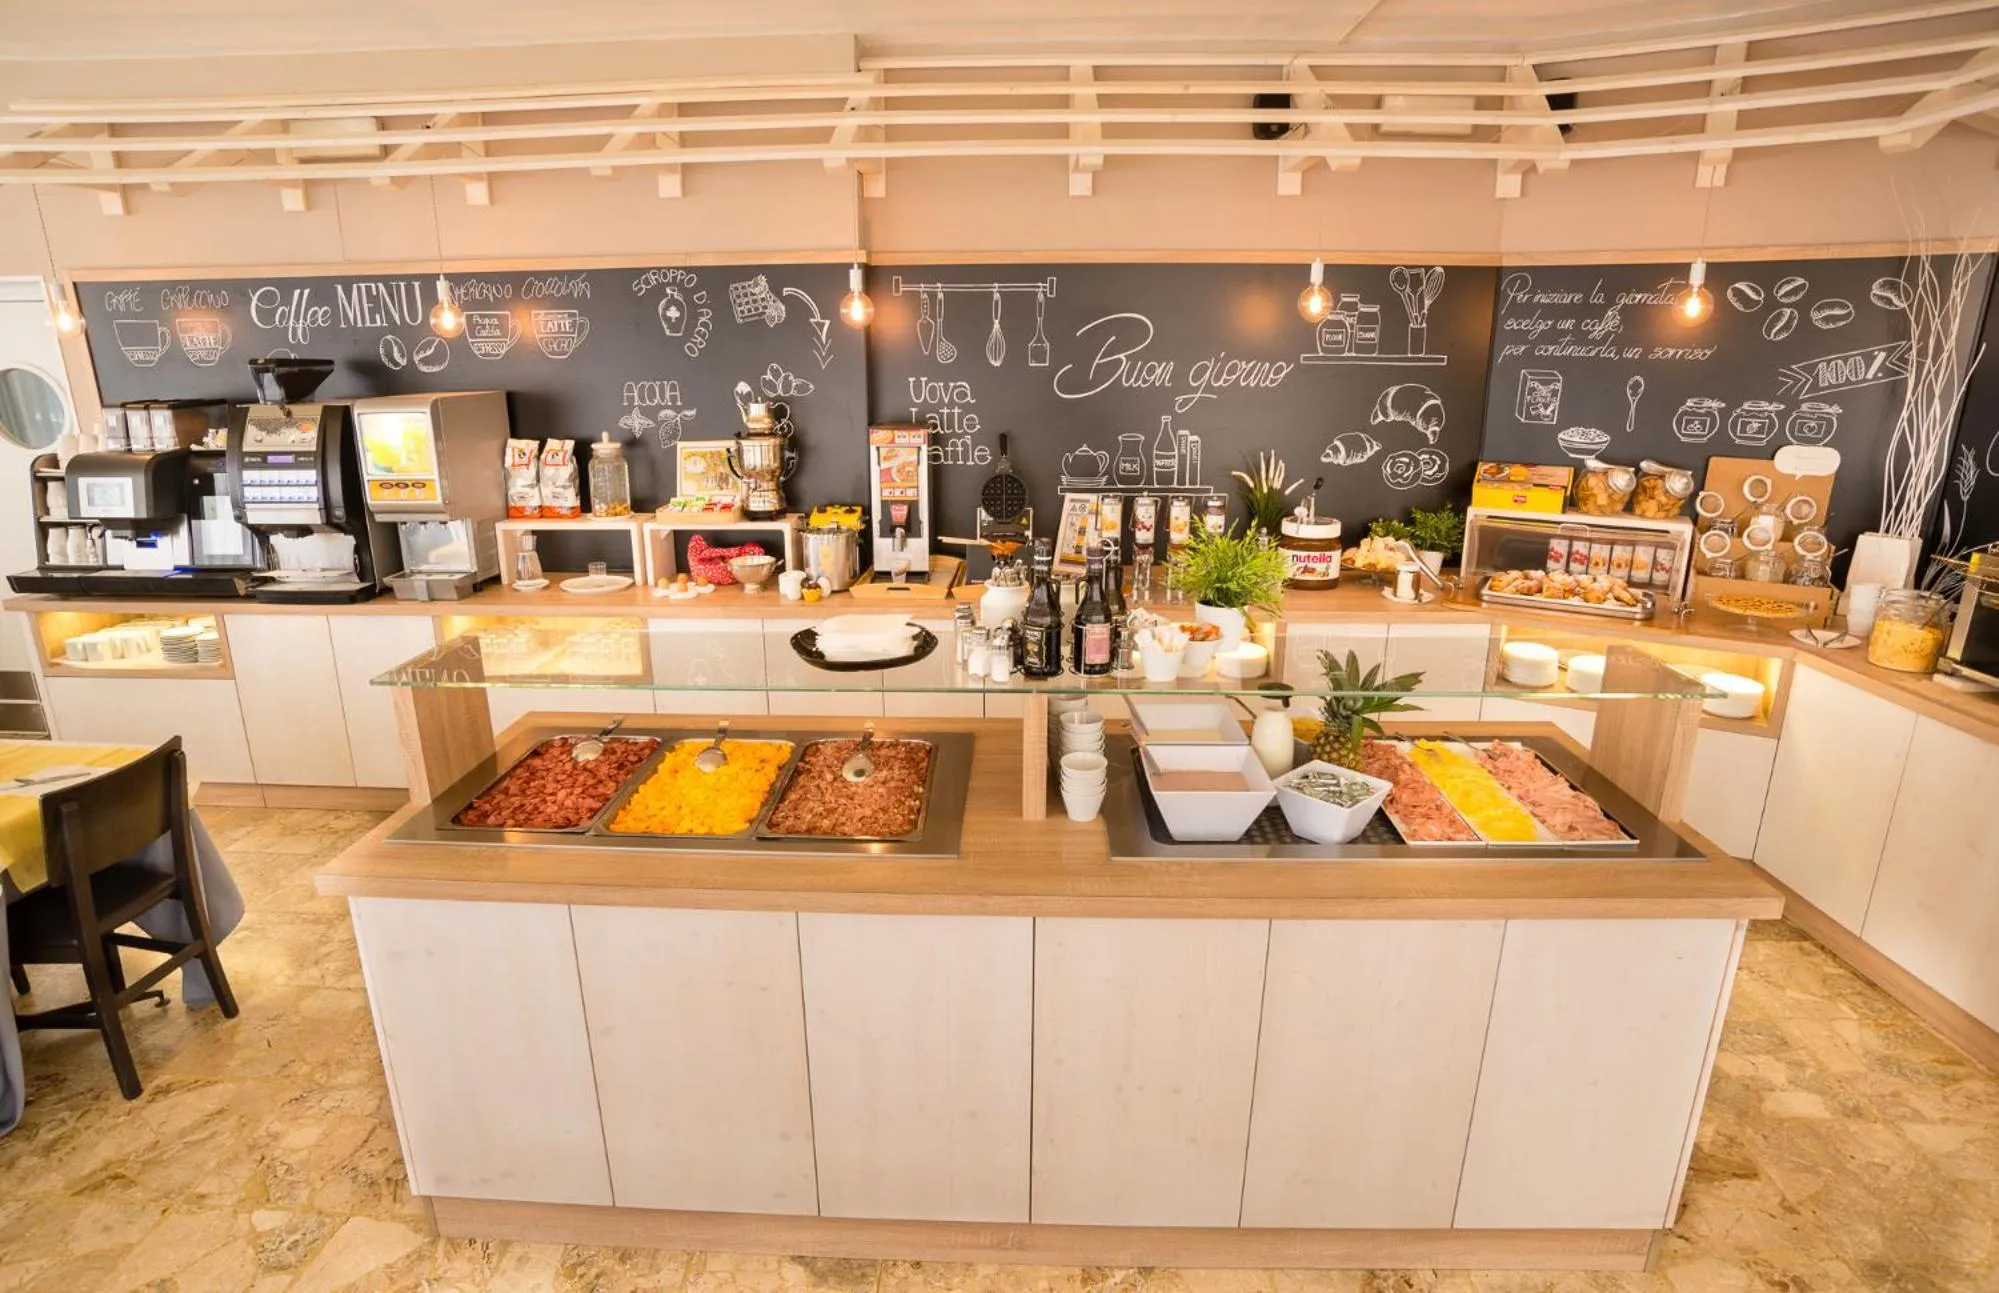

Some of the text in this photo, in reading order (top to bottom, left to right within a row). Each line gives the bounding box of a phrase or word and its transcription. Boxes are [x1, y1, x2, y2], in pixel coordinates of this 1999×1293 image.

[521, 273, 591, 300] CIOCCOLATA
[632, 269, 697, 297] SCIROPPO
[1501, 273, 1533, 314] Per
[1534, 290, 1583, 305] iniziare
[1589, 278, 1605, 305] la
[248, 281, 423, 344] Coffee MENU
[541, 319, 575, 333] LATTE
[1556, 319, 1574, 330] un
[1054, 312, 1294, 413] Buon giorno
[1498, 344, 1530, 363] per
[1622, 346, 1643, 359] un
[1648, 344, 1718, 360] sorriso
[622, 379, 683, 407] ACQUA
[907, 377, 976, 404] Uova
[1121, 461, 1139, 471] MILK
[1291, 551, 1333, 565] nutella
